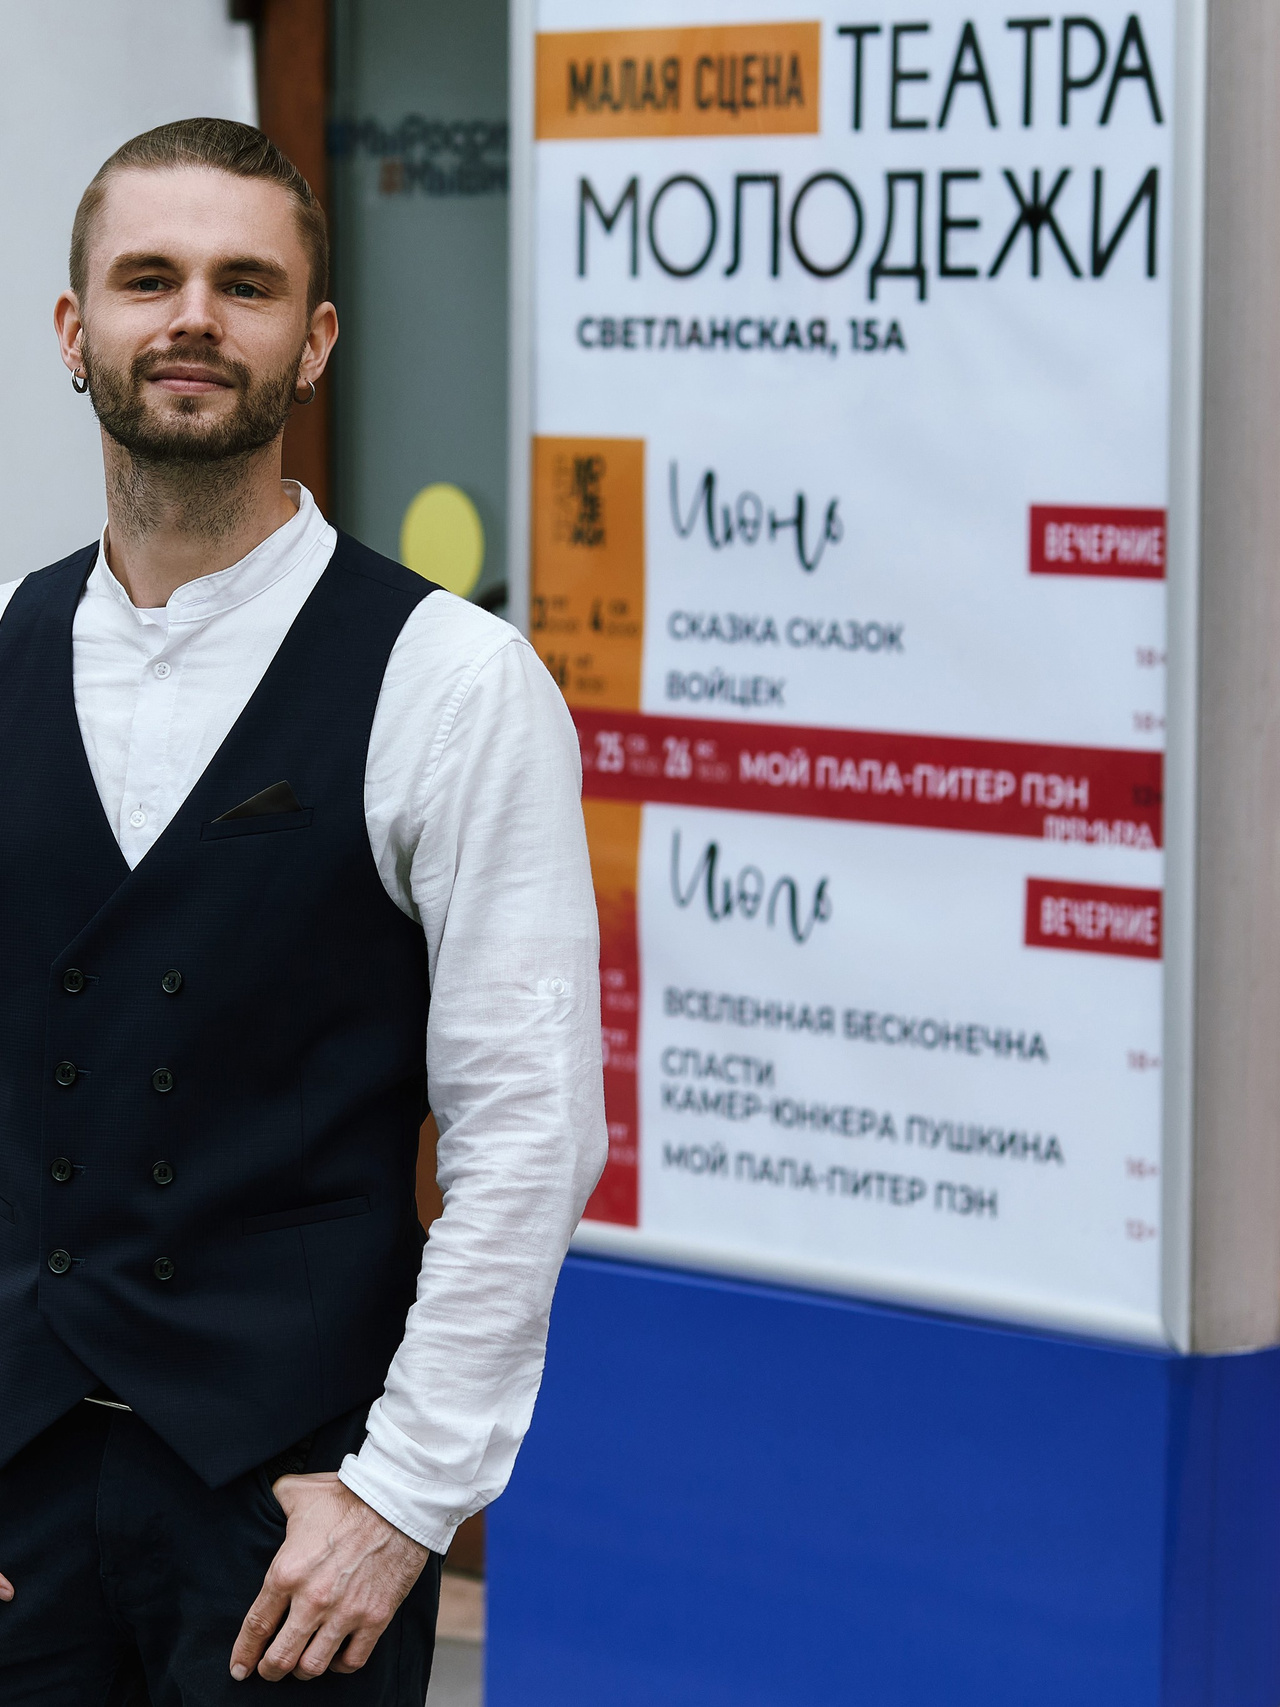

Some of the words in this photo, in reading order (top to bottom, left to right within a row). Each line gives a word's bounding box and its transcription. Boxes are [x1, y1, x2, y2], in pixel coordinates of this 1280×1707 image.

[567, 58, 681, 114] МАЛАЯ
[694, 52, 805, 117] СЦЕНА
[838, 14, 1164, 132] ТЕАТРА
[577, 166, 1159, 302] МОЛОДЕЖИ
[577, 317, 838, 357] СВЕТЛАНСКАЯ,
[850, 318, 907, 353] 15А
[669, 459, 844, 572] Июнь
[1045, 520, 1165, 567] ВЕЧЕРНИЕ
[667, 609, 780, 646] СКАЗКА
[786, 615, 907, 655] СКАЗОК
[666, 669, 786, 708] ВОЙЦЕК
[596, 730, 624, 773] 25
[739, 748, 810, 784] МОЙ
[816, 755, 1016, 805] ПАПА-ПИТЕР
[1021, 772, 1090, 812] ПЭН
[670, 829, 834, 945] Июль
[1040, 895, 1158, 946] ВЕЧЕРНИЕ
[663, 985, 835, 1037] ВСЕЛЕННАЯ
[842, 1010, 1049, 1064] БЕСКОНЕЧНА
[661, 1046, 775, 1088] СПАСТИ
[661, 1085, 898, 1143] КАМЕР-ЮНКЕРА
[904, 1113, 1065, 1166] ПУШКИНА
[662, 1141, 728, 1176] МОЙ
[734, 1150, 926, 1209] ПАПА-ПИТЕР
[933, 1182, 999, 1218] ПЭН
